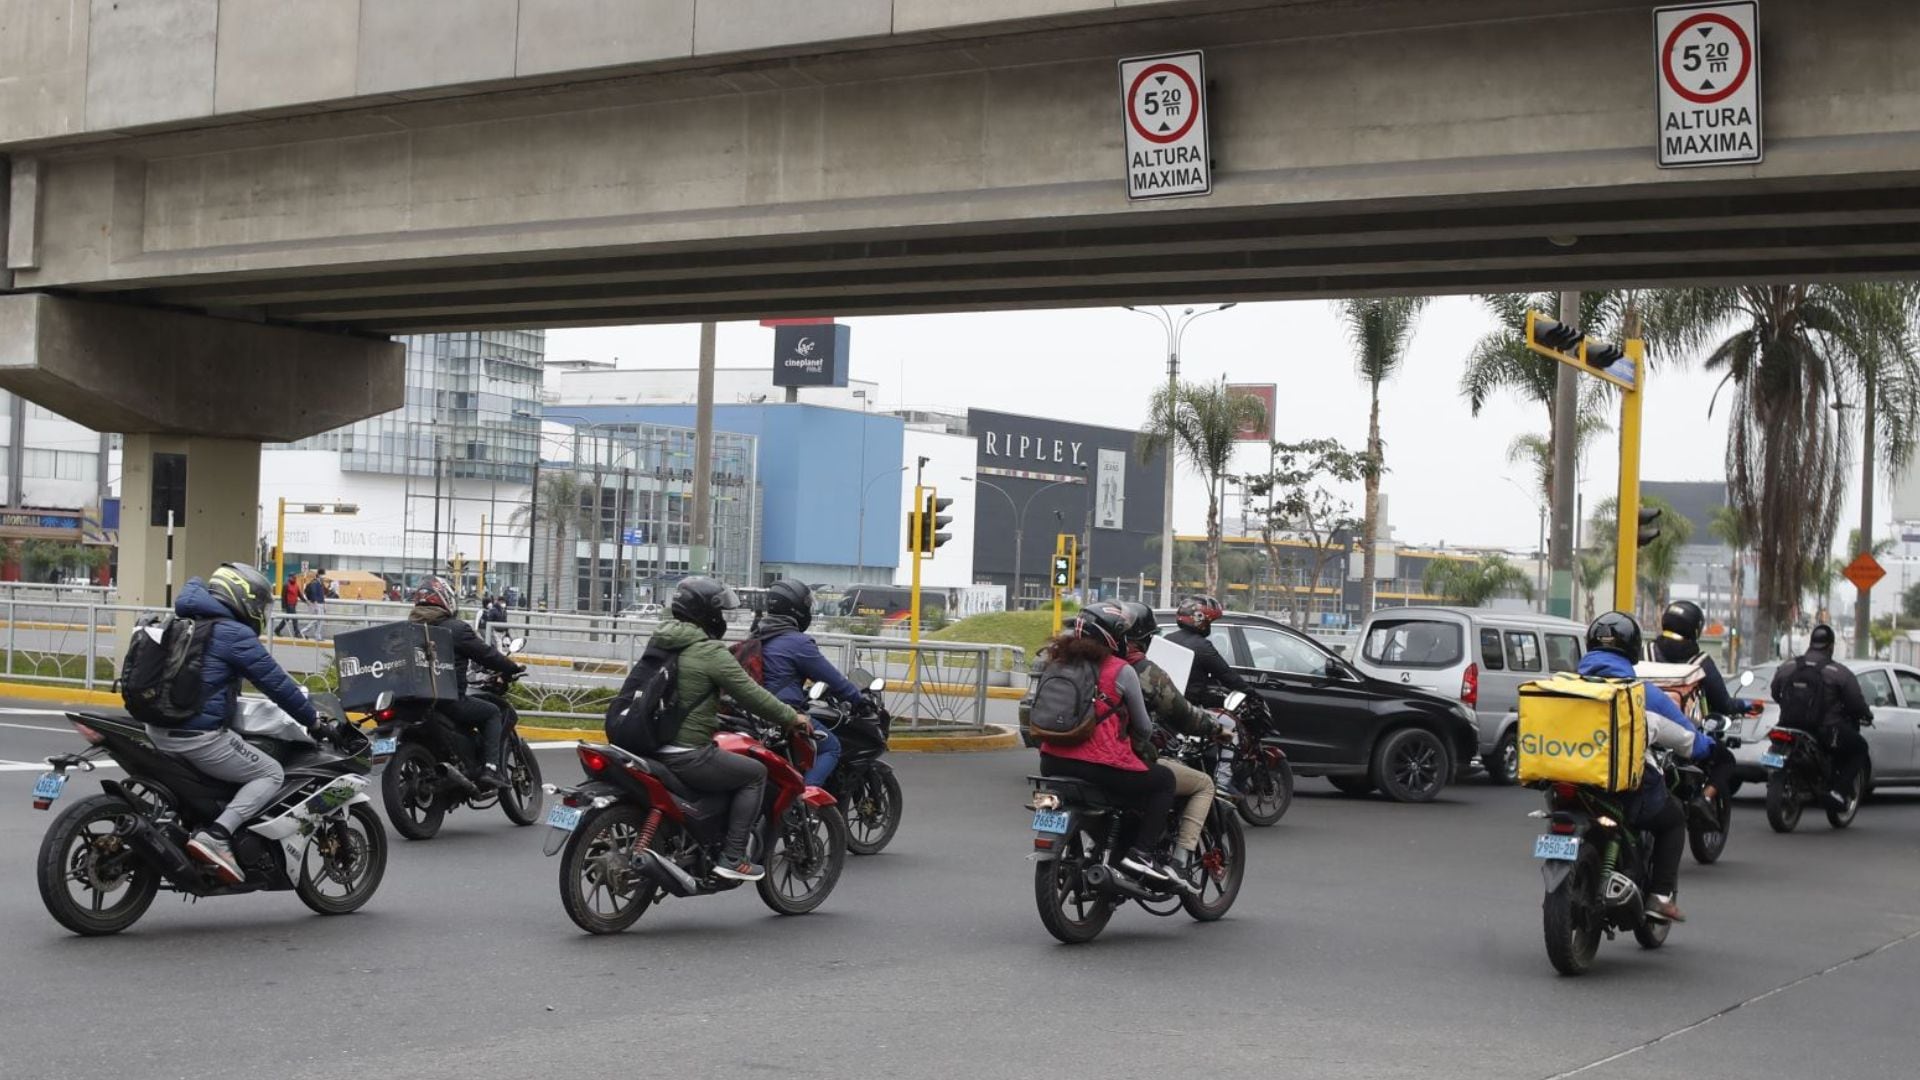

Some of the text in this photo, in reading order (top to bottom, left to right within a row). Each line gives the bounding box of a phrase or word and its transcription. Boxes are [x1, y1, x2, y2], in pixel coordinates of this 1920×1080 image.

[1683, 42, 1729, 71] 5 20
[1710, 61, 1727, 73] m
[1144, 89, 1181, 115] 5 20
[1166, 105, 1180, 116] m
[1665, 107, 1752, 131] ALTURA
[1666, 132, 1753, 156] MAXIMA
[1132, 145, 1201, 168] ALTURA
[1133, 167, 1203, 190] MAXIMA
[784, 358, 823, 368] cineplanet
[985, 431, 1083, 465] RIPLEY
[1521, 733, 1595, 758] Glovo
